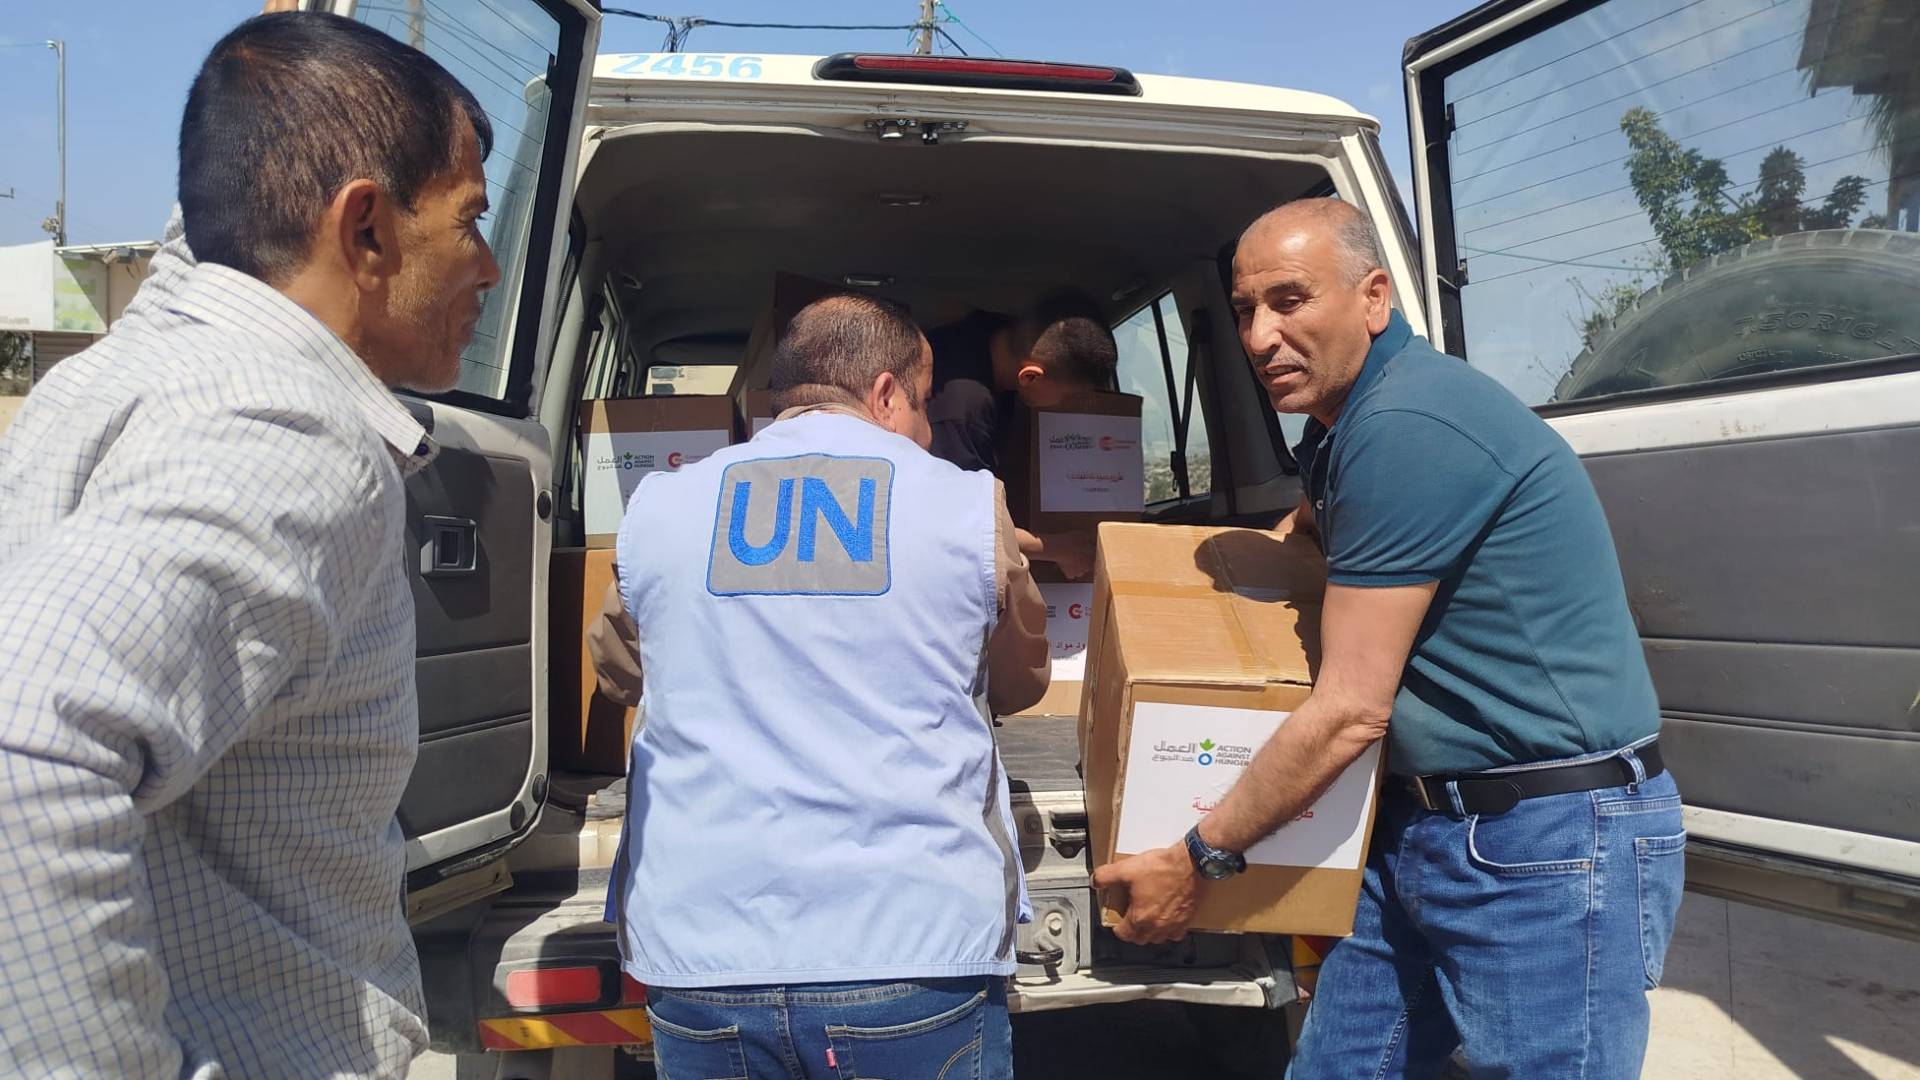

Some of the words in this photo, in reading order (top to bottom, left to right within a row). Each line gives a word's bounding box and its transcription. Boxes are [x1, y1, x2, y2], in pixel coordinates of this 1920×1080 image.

[611, 54, 763, 79] 2456
[728, 475, 877, 567] UN
[1153, 740, 1196, 753] العمل
[1216, 745, 1252, 754] ACTION
[1215, 752, 1251, 760] AGAINST
[1215, 759, 1250, 767] HUNGER
